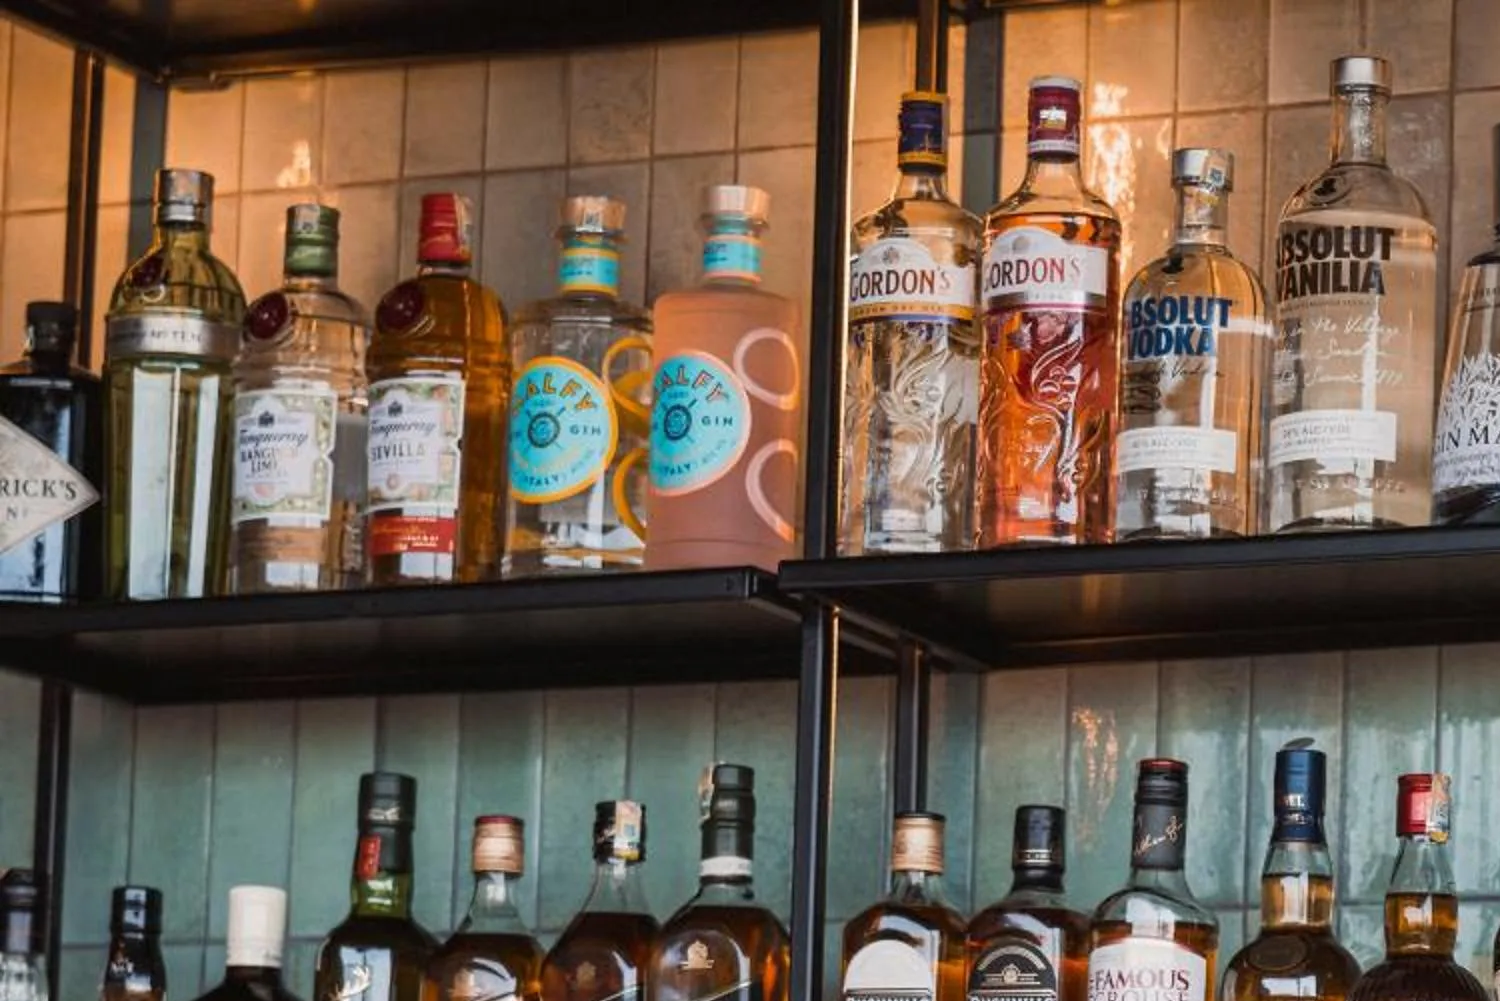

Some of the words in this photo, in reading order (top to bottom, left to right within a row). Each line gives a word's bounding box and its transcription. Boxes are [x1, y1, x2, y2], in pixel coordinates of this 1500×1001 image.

[1130, 295, 1232, 328] BSOLUT
[701, 415, 733, 427] GIN
[570, 426, 600, 436] GIN
[1093, 969, 1189, 992] FAMOUS
